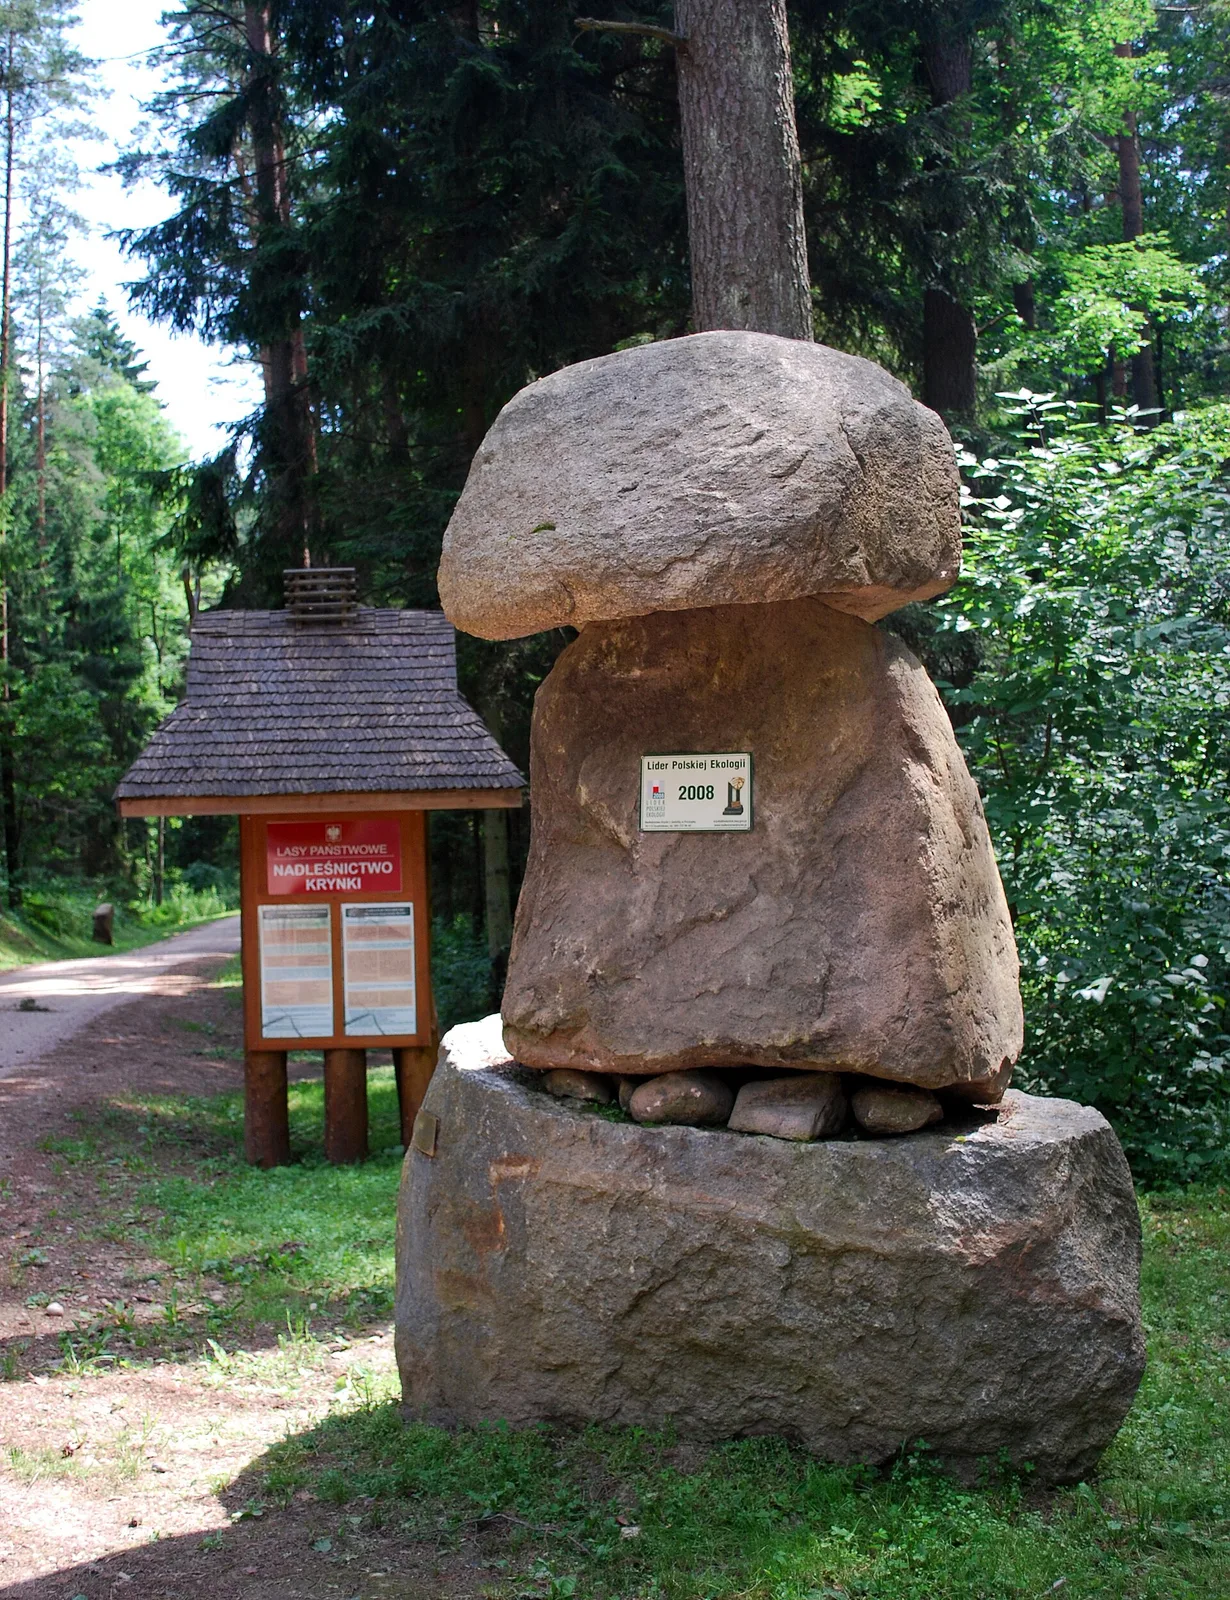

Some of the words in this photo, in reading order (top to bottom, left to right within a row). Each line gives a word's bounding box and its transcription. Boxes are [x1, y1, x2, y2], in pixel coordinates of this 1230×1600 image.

[647, 761, 669, 770] Lider
[672, 760, 707, 771] Polskiej
[710, 759, 746, 770] Ekologii
[678, 785, 715, 800] 2008
[276, 846, 307, 857] LASY
[309, 843, 388, 856] PAŃSTWOWE
[273, 860, 393, 876] NADLEŚNICTWO
[305, 877, 362, 891] KRYNKI
